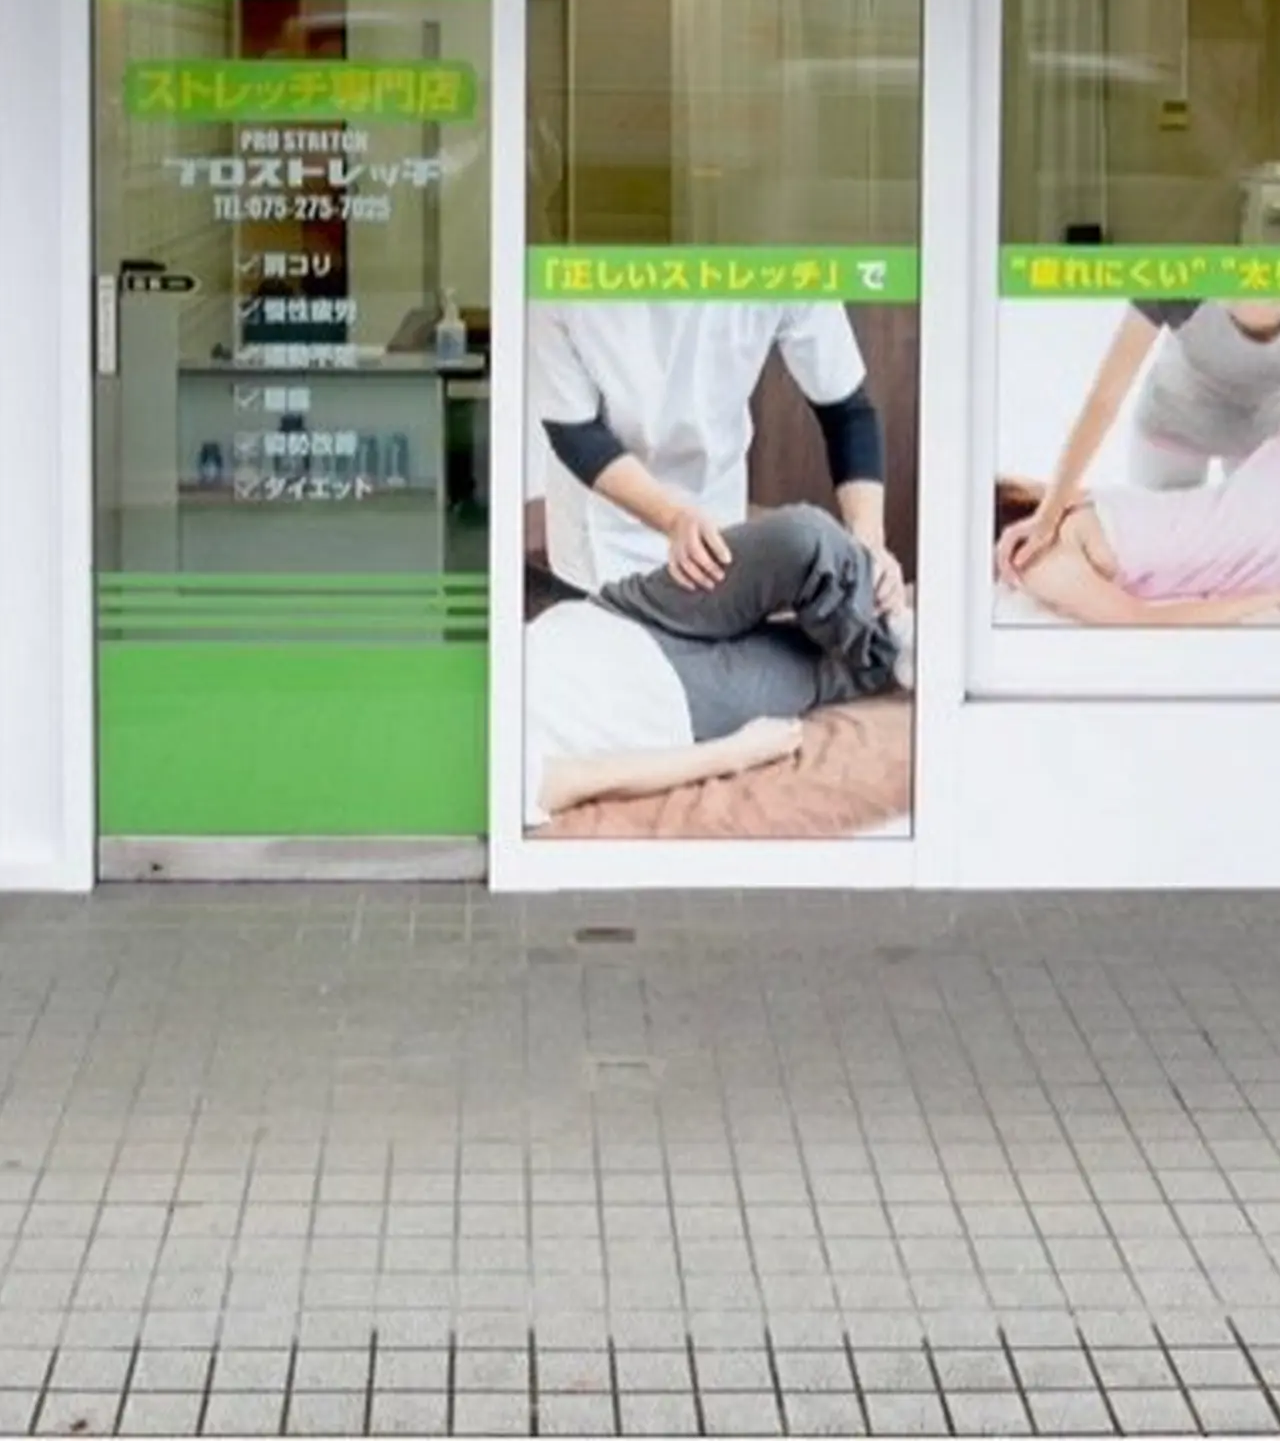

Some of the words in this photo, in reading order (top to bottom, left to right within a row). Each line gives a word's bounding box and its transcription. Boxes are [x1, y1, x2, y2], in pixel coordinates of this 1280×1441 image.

[136, 68, 462, 113] ストレッチ専門店
